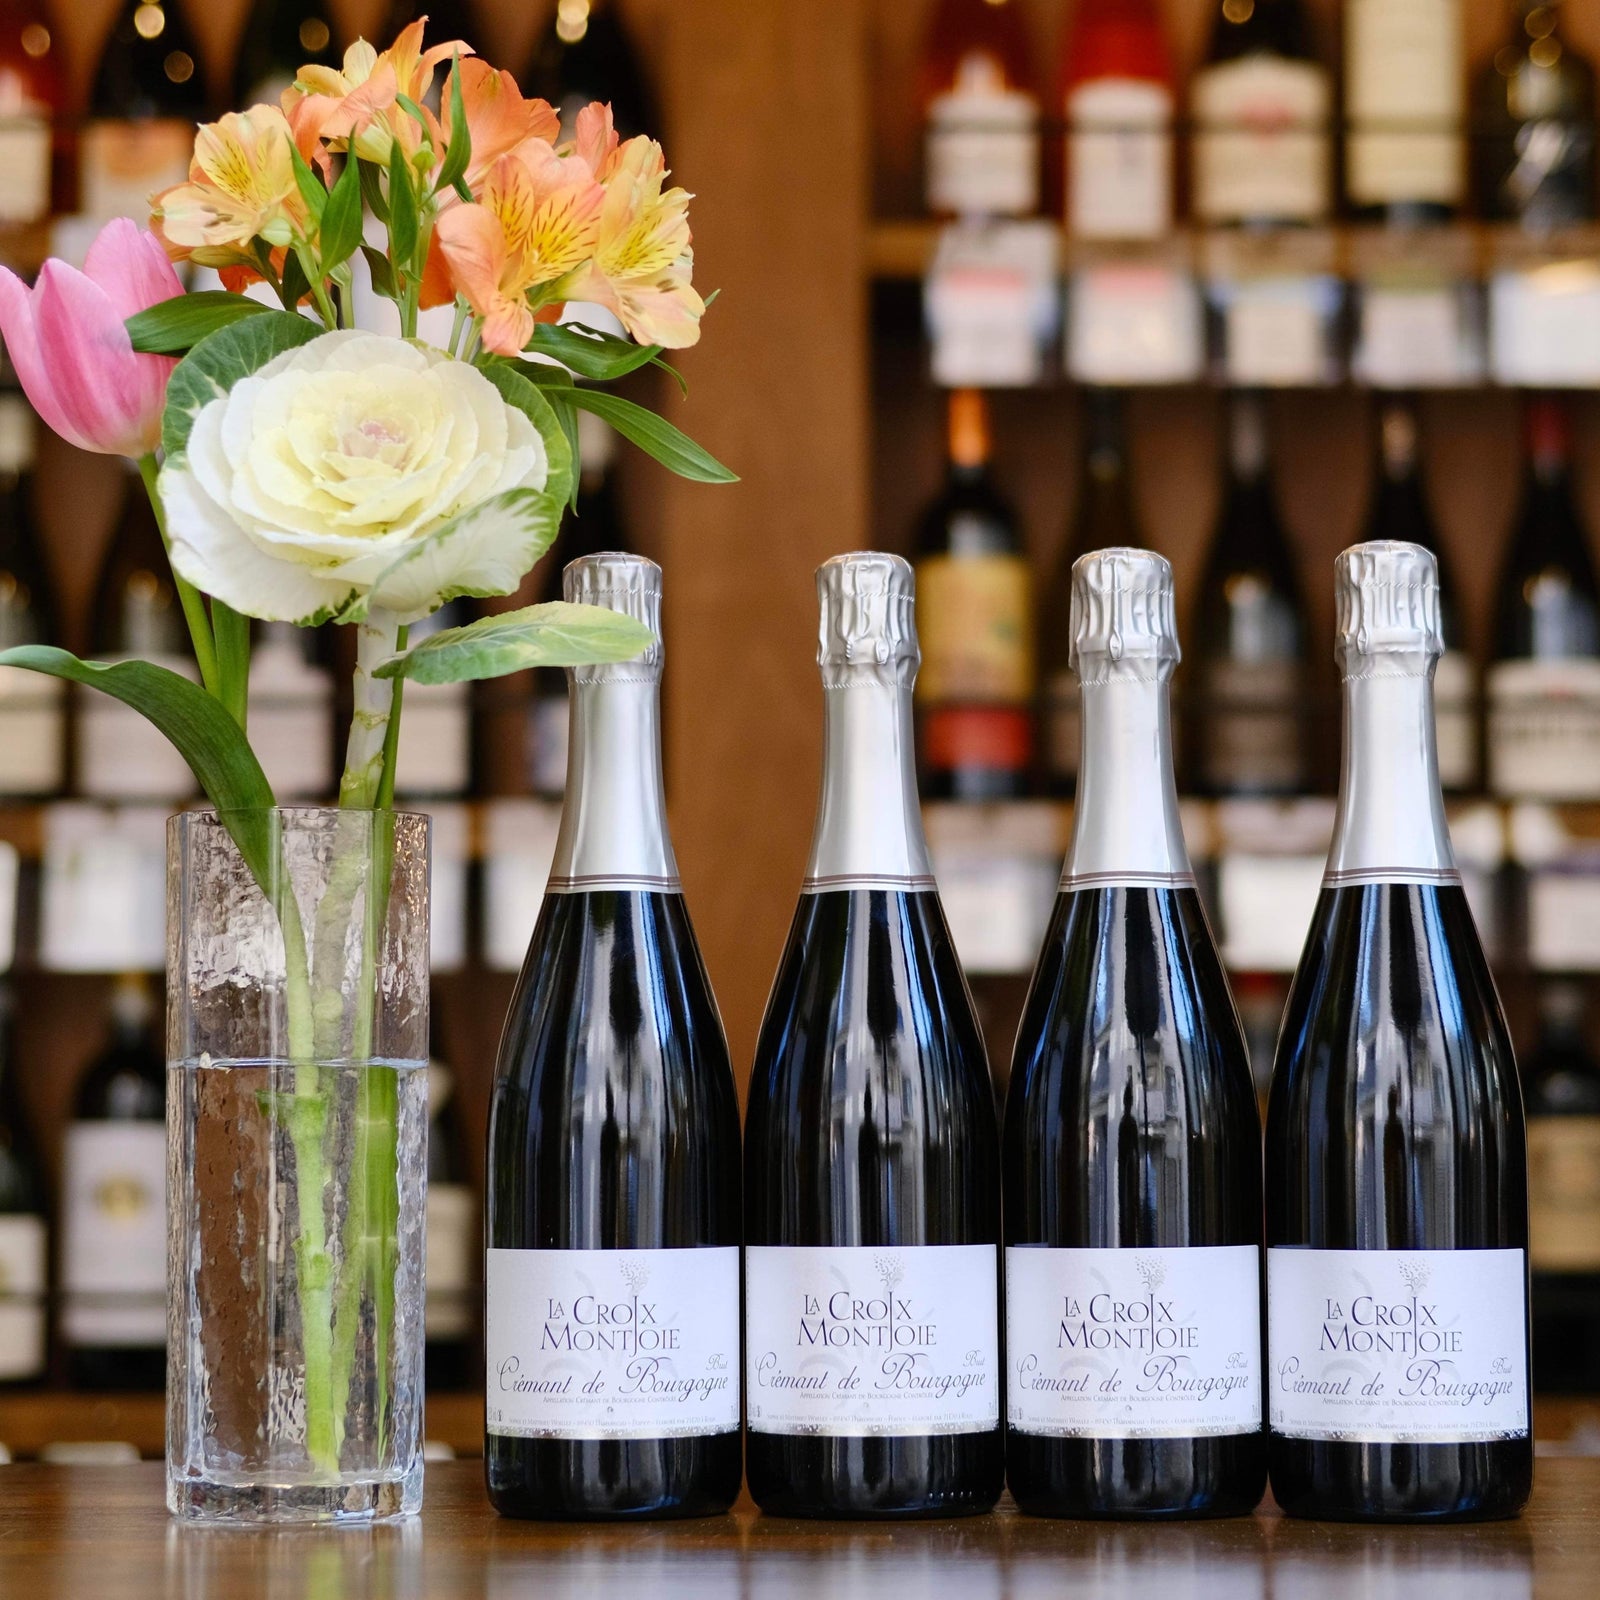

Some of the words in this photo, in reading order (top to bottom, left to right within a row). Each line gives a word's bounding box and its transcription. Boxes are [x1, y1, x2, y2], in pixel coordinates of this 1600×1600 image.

[548, 1299, 564, 1319] LA
[804, 1295, 820, 1315] LA
[1064, 1297, 1081, 1317] LA
[1326, 1299, 1343, 1319] LA
[541, 1322, 680, 1357] MONTJOIE
[796, 1318, 937, 1353] MONTJOIE
[1057, 1320, 1198, 1355] MONTJOIE
[1319, 1322, 1462, 1359] MONTJOIE
[497, 1356, 572, 1393] Crémant
[582, 1370, 605, 1394] de
[619, 1357, 729, 1402] Bourgogne
[755, 1352, 828, 1389] Crémant
[838, 1366, 860, 1389] de
[875, 1353, 985, 1398] Bourgogne
[1016, 1354, 1089, 1392] Crémant
[1099, 1368, 1122, 1392] de
[1136, 1355, 1249, 1401] Bourgogne
[1278, 1356, 1351, 1396] Crémant
[1362, 1372, 1384, 1396] de
[1399, 1360, 1513, 1406] Bourgogne
